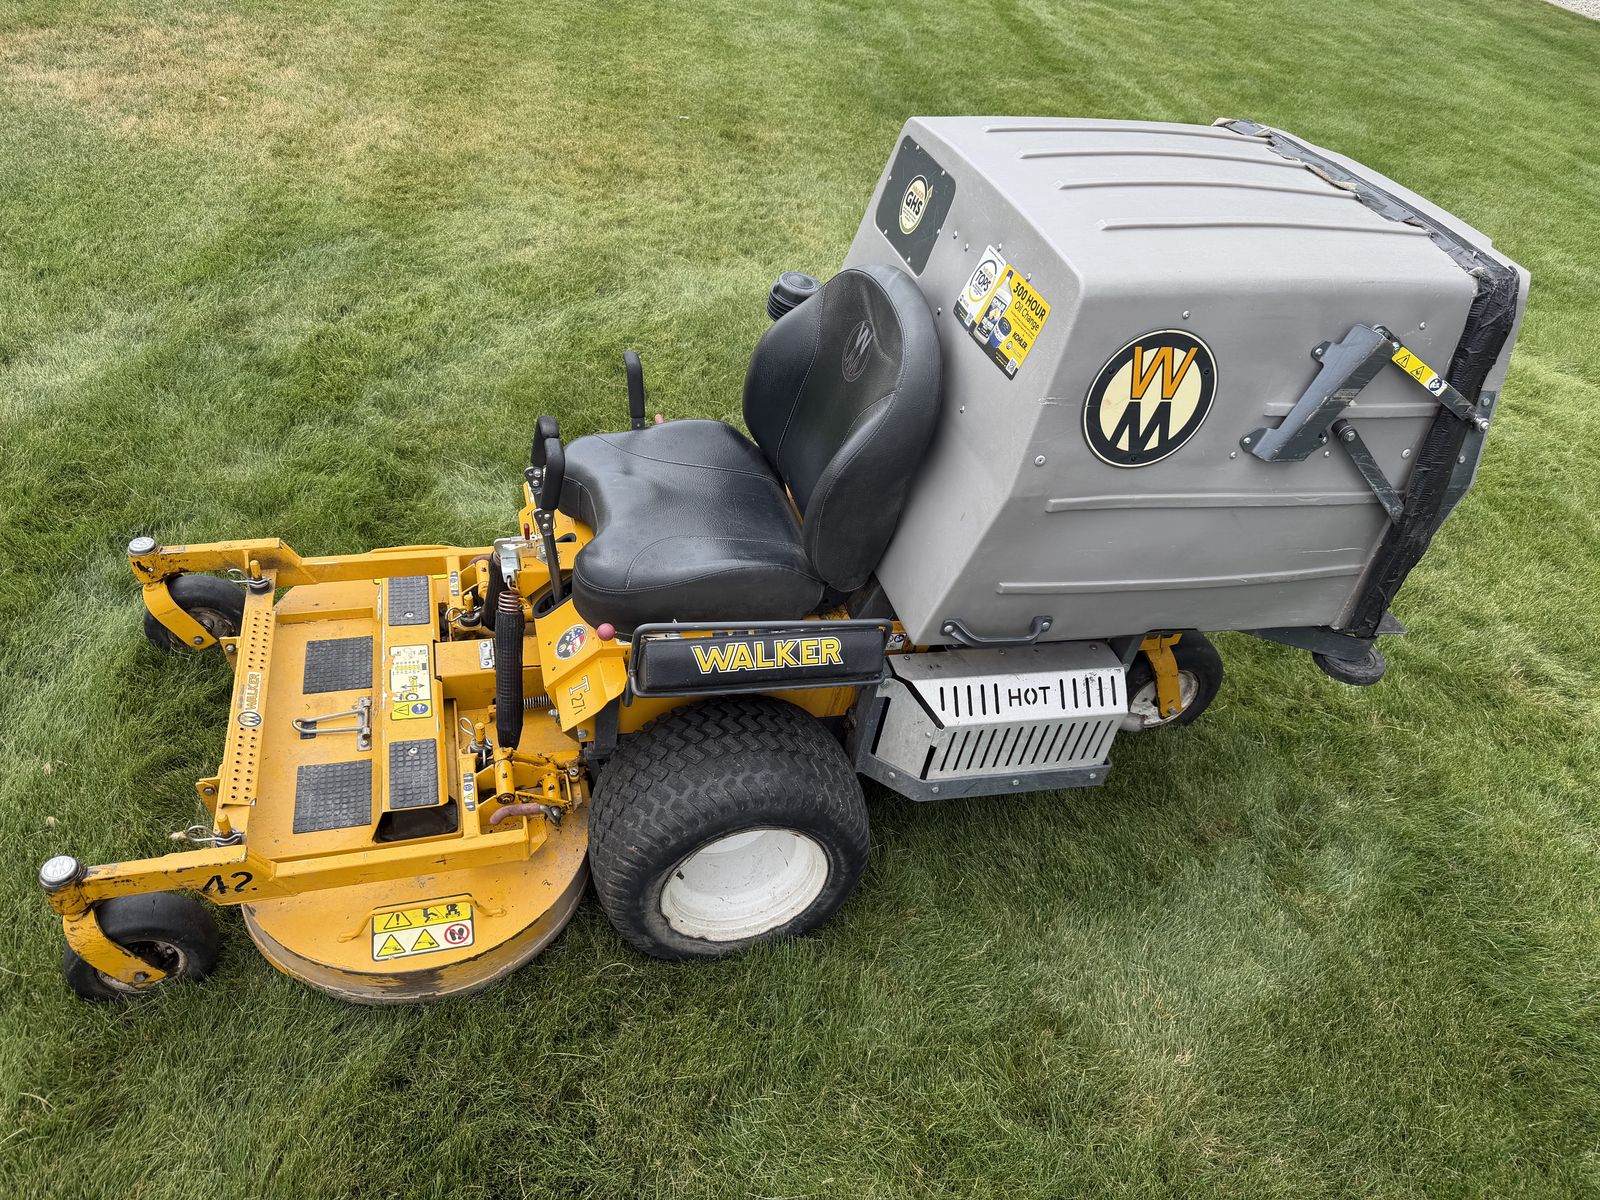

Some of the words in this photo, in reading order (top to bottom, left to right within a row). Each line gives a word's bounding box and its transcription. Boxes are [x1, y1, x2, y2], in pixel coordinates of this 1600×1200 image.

[905, 192, 923, 216] GHS
[975, 269, 992, 292] TOPS
[1013, 281, 1028, 301] 300
[1026, 294, 1047, 322] HOUR
[1014, 301, 1023, 315] Oil
[1021, 308, 1041, 332] Change
[690, 636, 844, 675] WALKER
[245, 673, 260, 711] WALKER
[1008, 686, 1051, 708] HOT
